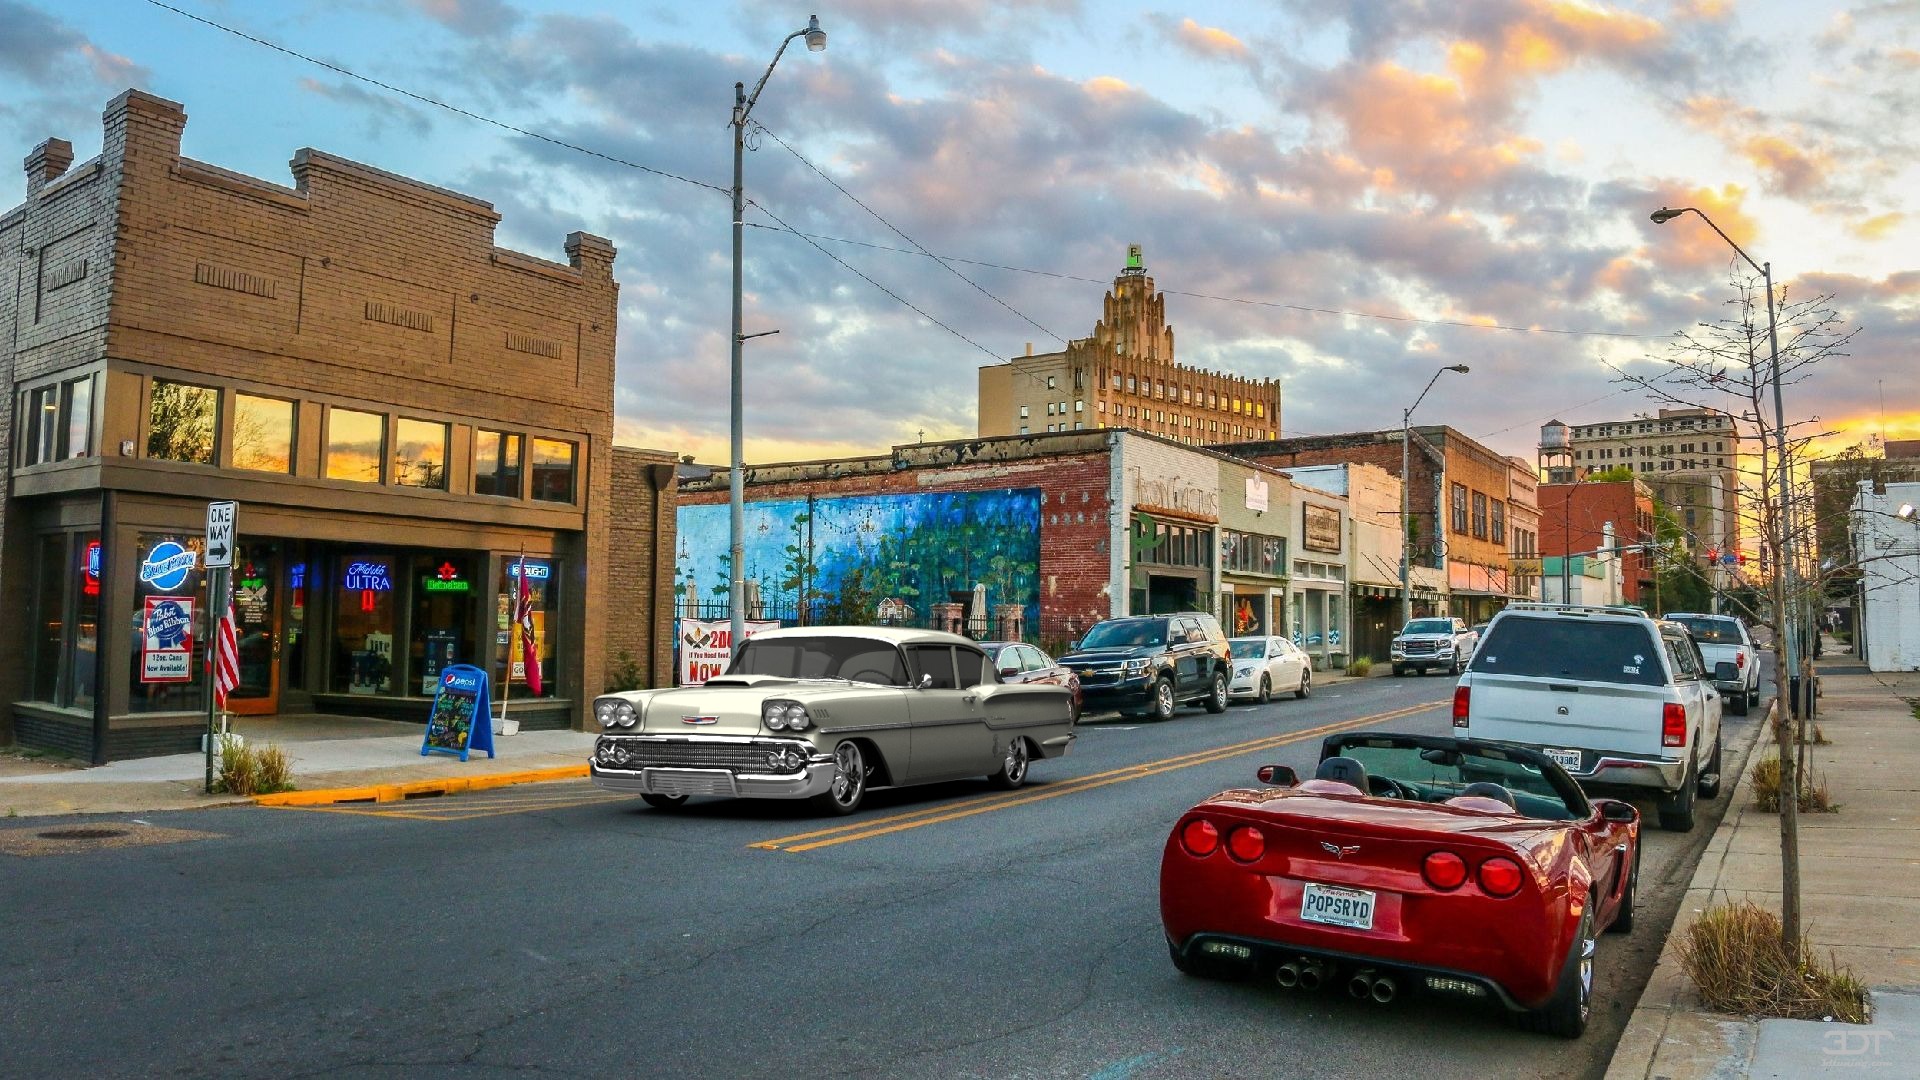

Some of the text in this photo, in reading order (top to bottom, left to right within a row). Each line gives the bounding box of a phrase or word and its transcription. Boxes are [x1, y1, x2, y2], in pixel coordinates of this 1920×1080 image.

[211, 507, 230, 523] ONE
[209, 525, 230, 541] WAY
[346, 575, 390, 590] ULTRA
[153, 607, 176, 622] Pabst
[147, 616, 190, 639] Blue Ribbon
[169, 654, 183, 662] Cans
[147, 664, 187, 672] Now Available!
[455, 678, 476, 686] pepsi
[1306, 893, 1369, 919] POPSRYD
